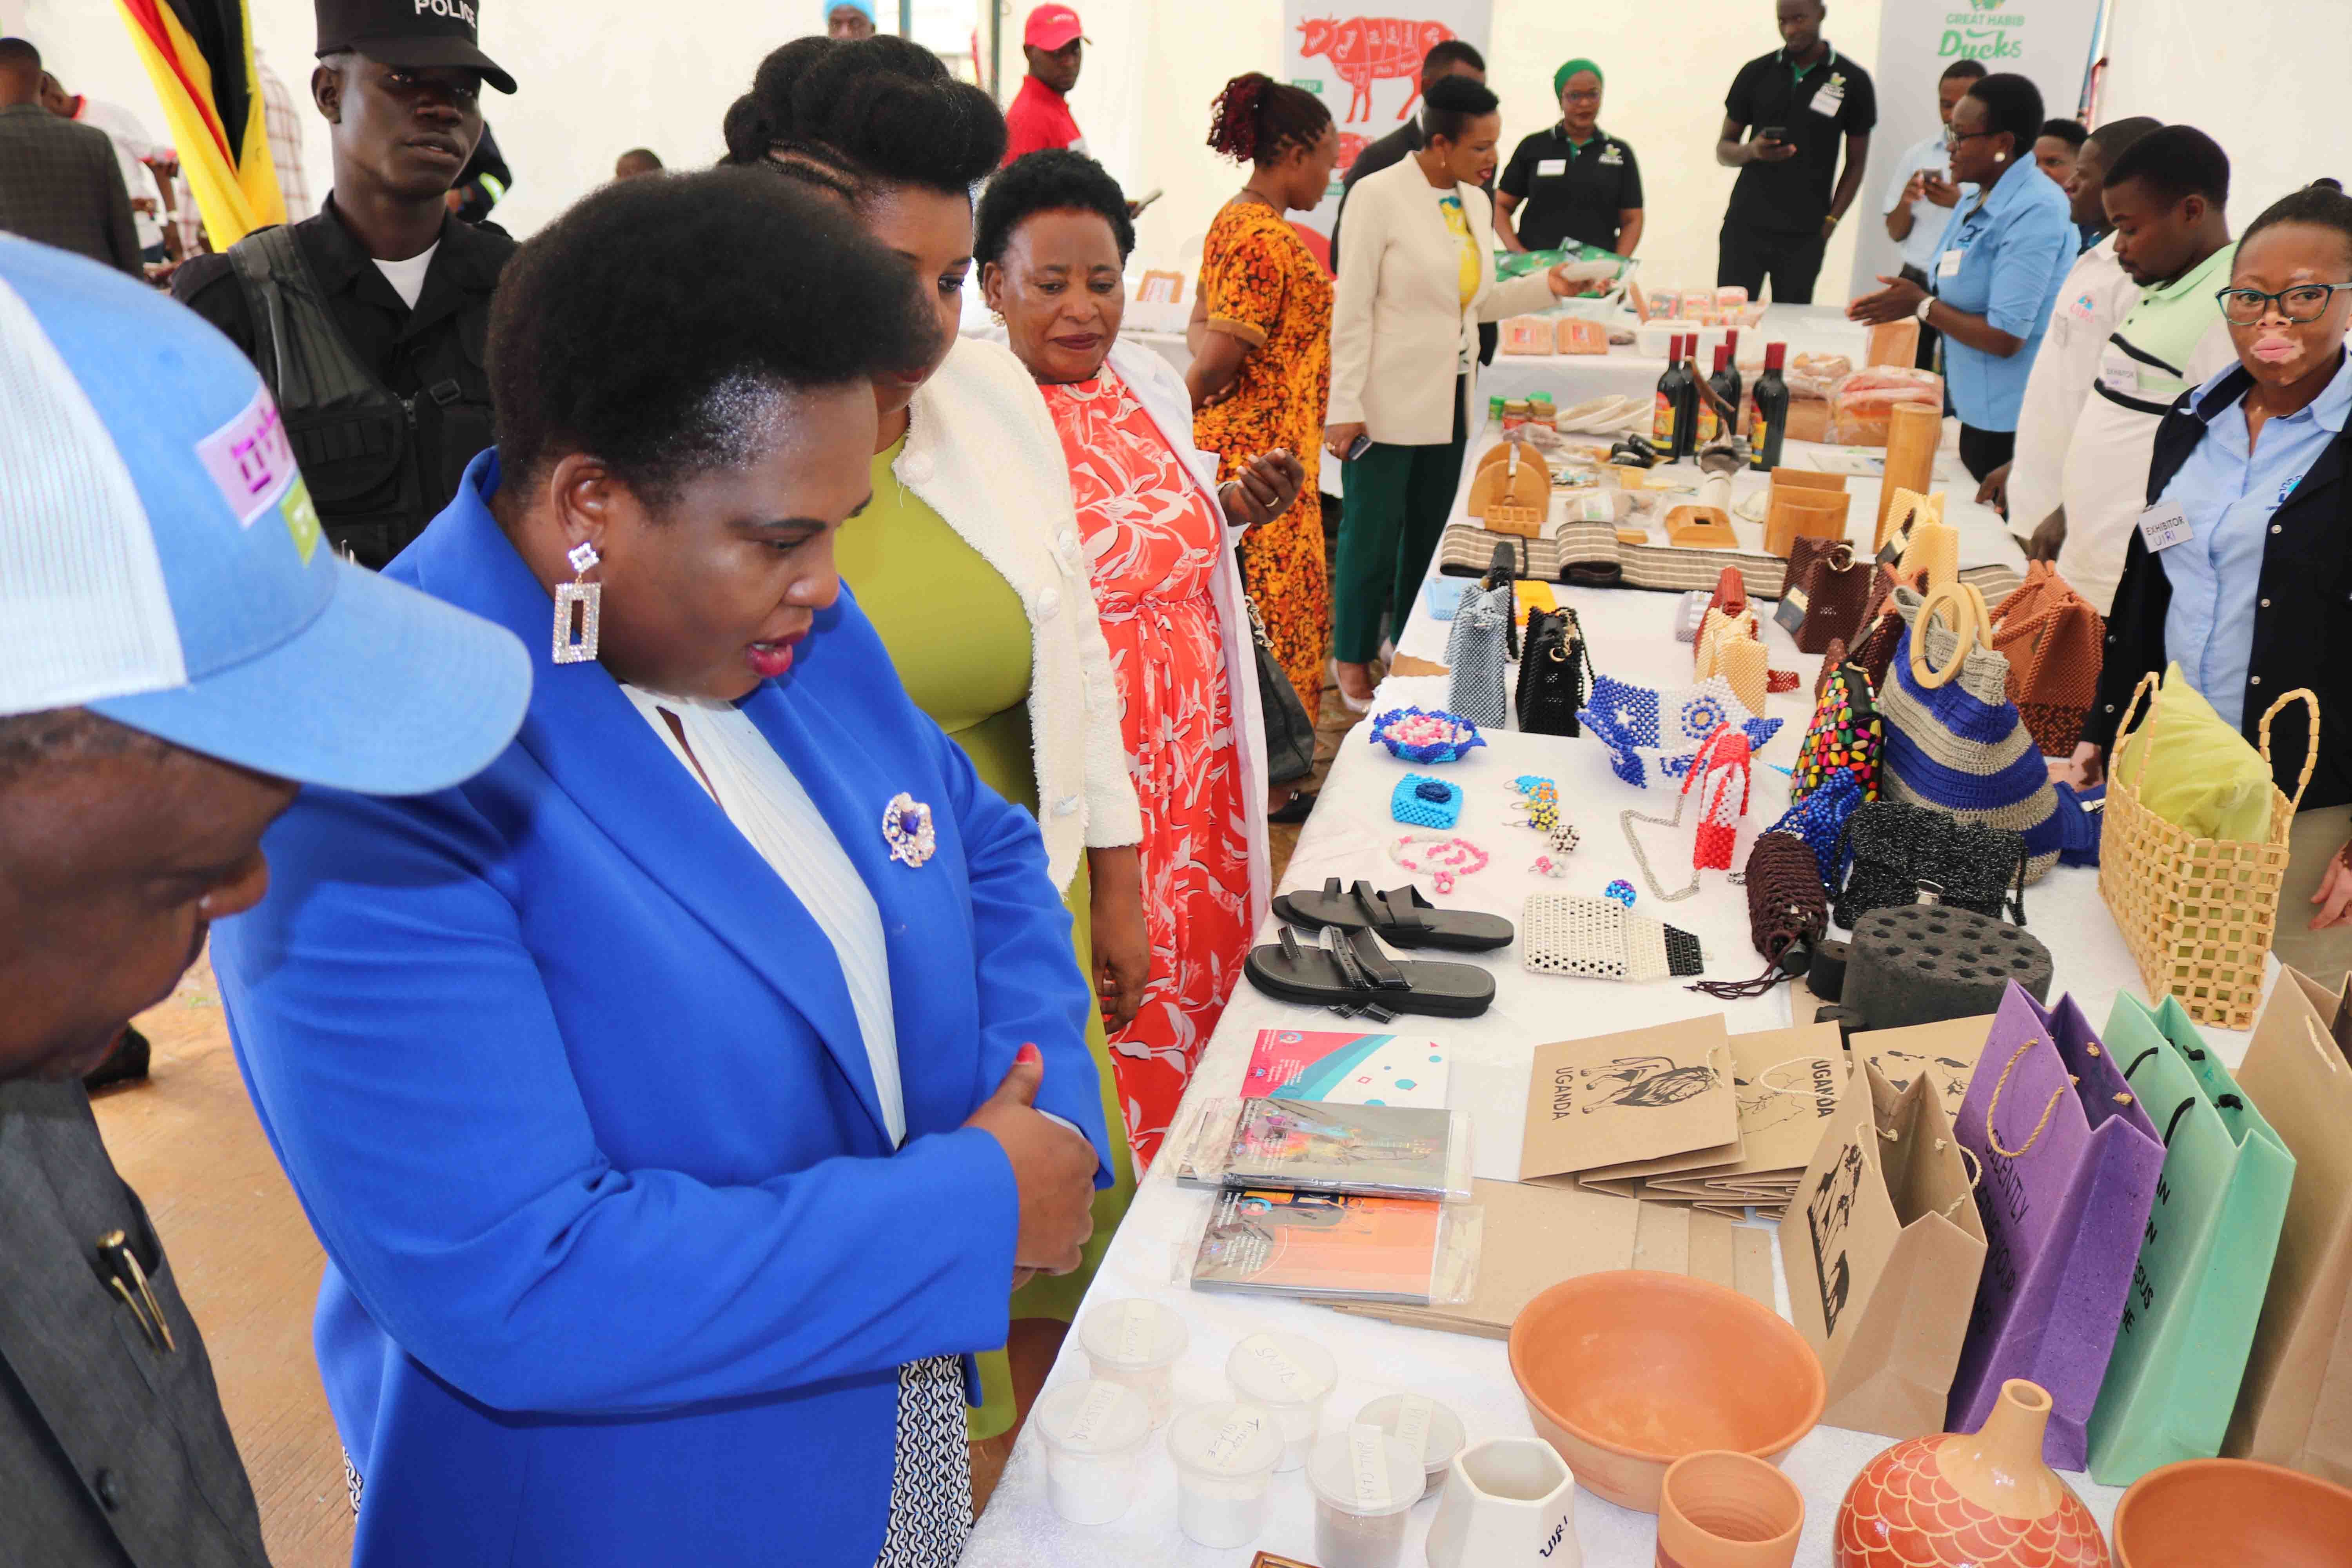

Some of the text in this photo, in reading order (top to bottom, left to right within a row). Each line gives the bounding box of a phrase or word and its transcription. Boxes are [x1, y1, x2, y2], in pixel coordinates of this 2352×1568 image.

[1946, 13, 2025, 27] GREAT HABIB
[1938, 29, 2022, 60] Ducks
[2146, 515, 2185, 536] EXHIBITOR
[1552, 1066, 1573, 1121] UGANDA
[1811, 1060, 1834, 1118] UGANDA
[1539, 1515, 1568, 1557] UIRI
